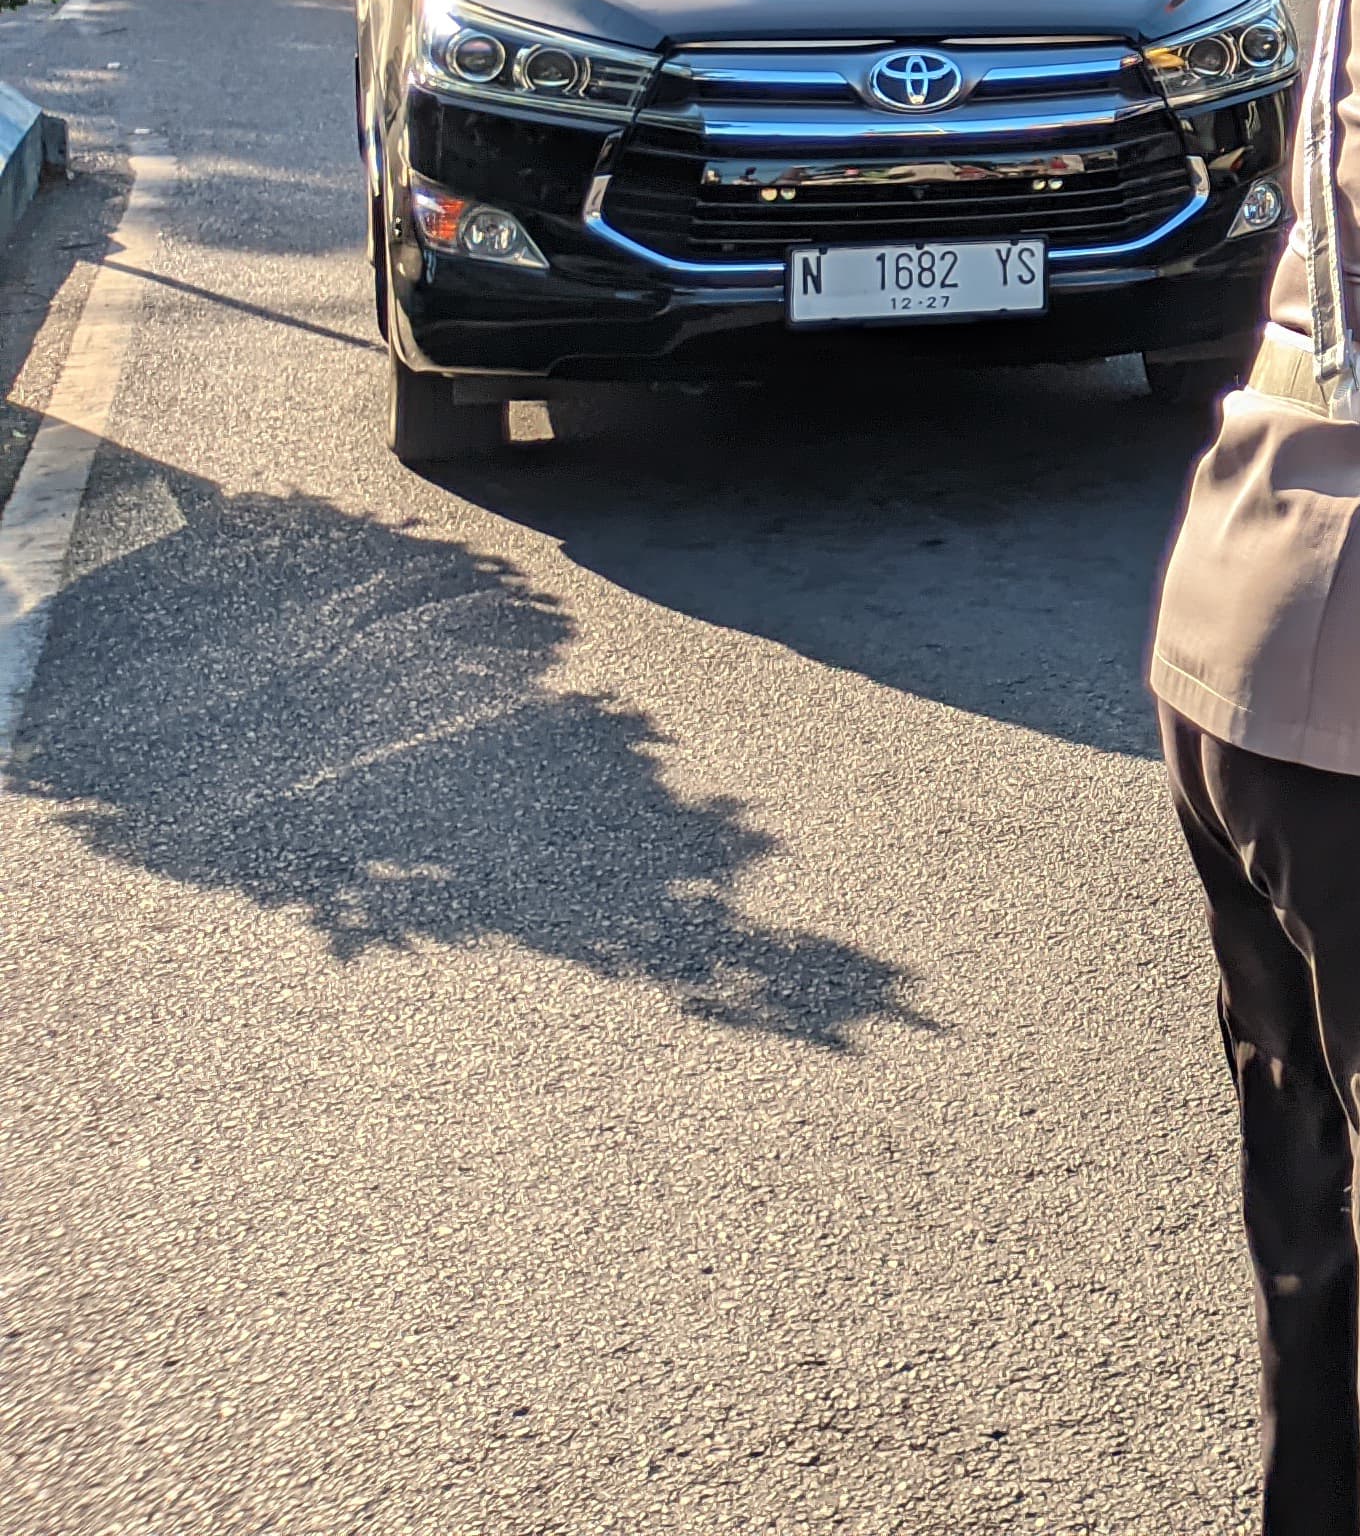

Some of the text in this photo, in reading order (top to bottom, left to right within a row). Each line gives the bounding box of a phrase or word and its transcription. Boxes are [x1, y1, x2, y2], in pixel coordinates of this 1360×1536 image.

[802, 247, 1036, 296] N 1682 YS
